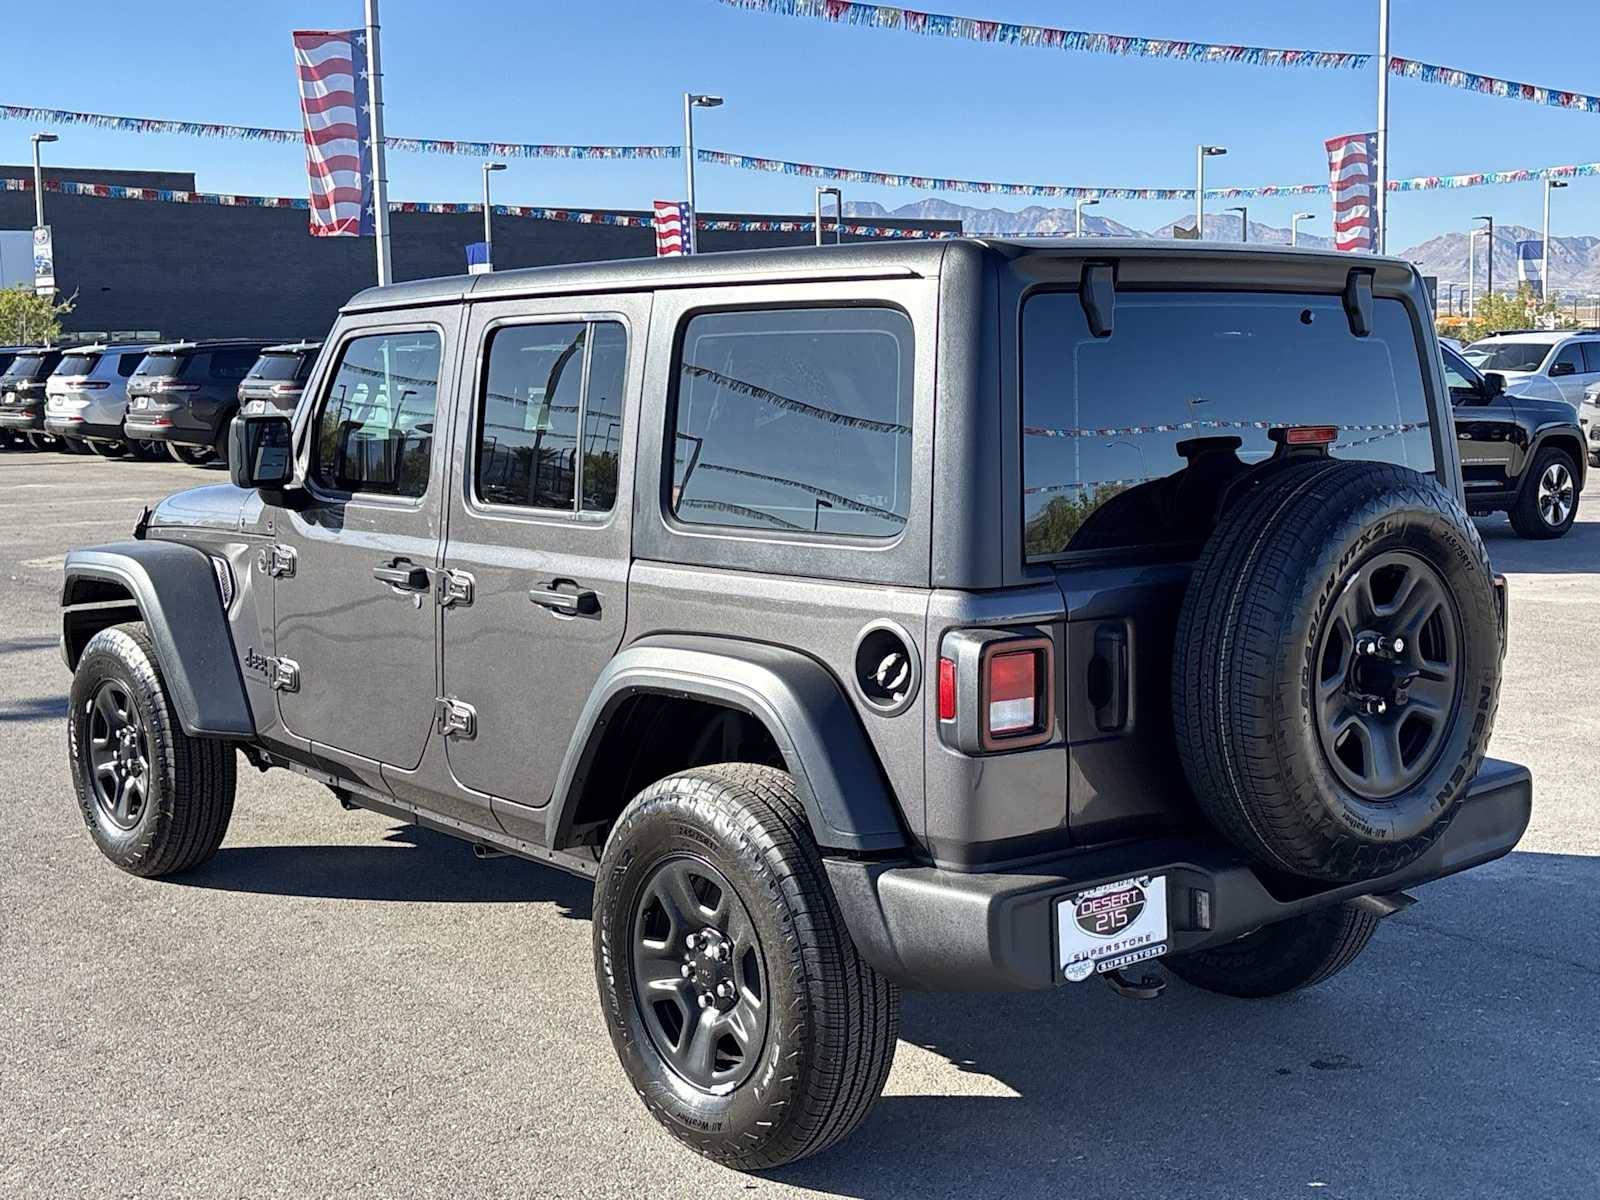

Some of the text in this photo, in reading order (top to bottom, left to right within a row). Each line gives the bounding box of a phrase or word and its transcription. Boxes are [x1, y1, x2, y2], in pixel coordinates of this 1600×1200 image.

[1435, 685, 1492, 809] NEXEN
[1081, 889, 1140, 915] DESERT
[1095, 908, 1129, 932] 215
[1073, 933, 1152, 962] SUPERSTORE
[1099, 946, 1165, 970] SUPERSTORE
